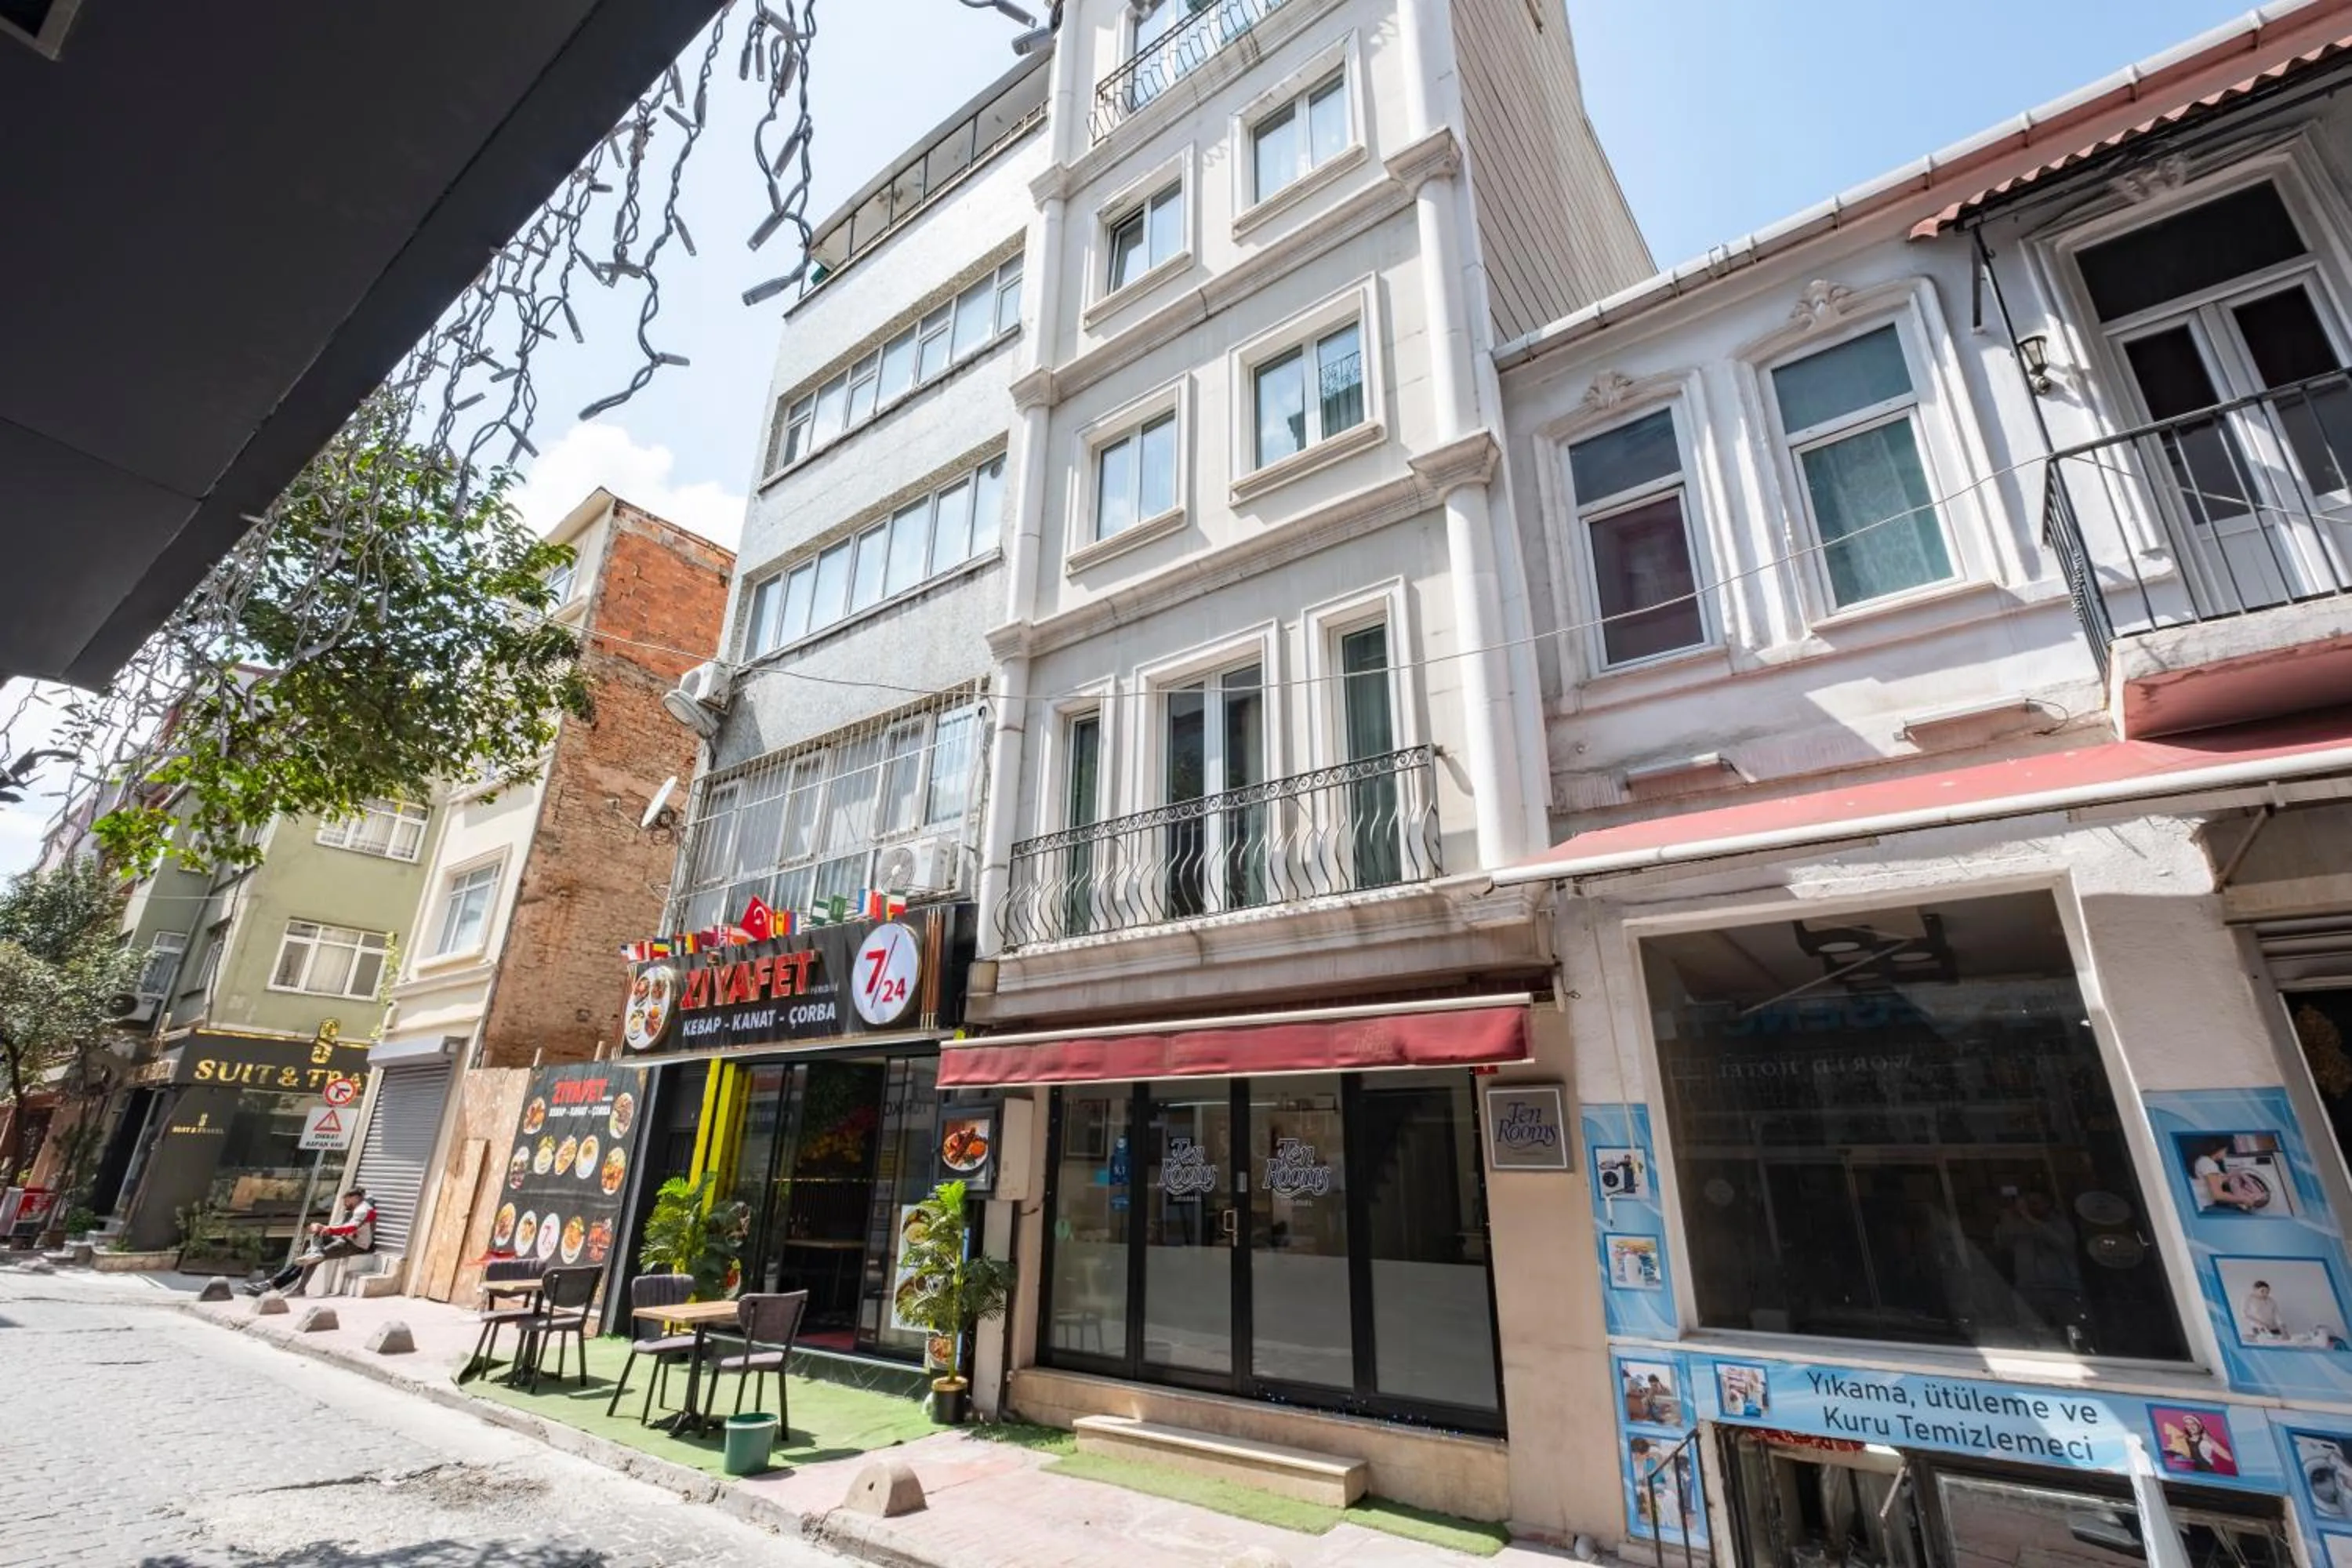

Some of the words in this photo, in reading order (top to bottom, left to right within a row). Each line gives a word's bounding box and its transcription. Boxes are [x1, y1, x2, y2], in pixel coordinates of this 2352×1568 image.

[682, 1016, 722, 1036] KEBAP
[731, 1009, 776, 1031] KANAT
[789, 1002, 837, 1029] ÇORBA
[194, 1059, 277, 1084] SUIT
[277, 1066, 299, 1088] &
[307, 1068, 370, 1089] TRA
[1507, 1102, 1541, 1125] Ten
[1496, 1118, 1557, 1149] Rooms
[1276, 1138, 1315, 1167] Ten
[1261, 1158, 1330, 1198] Rooms
[1806, 1371, 1916, 1409] Yıkama,
[1924, 1384, 2049, 1419] ütüleme
[2060, 1402, 2098, 1425] ve
[1823, 1406, 1890, 1437] Kuru
[1896, 1414, 2095, 1461] Temizlemeci
